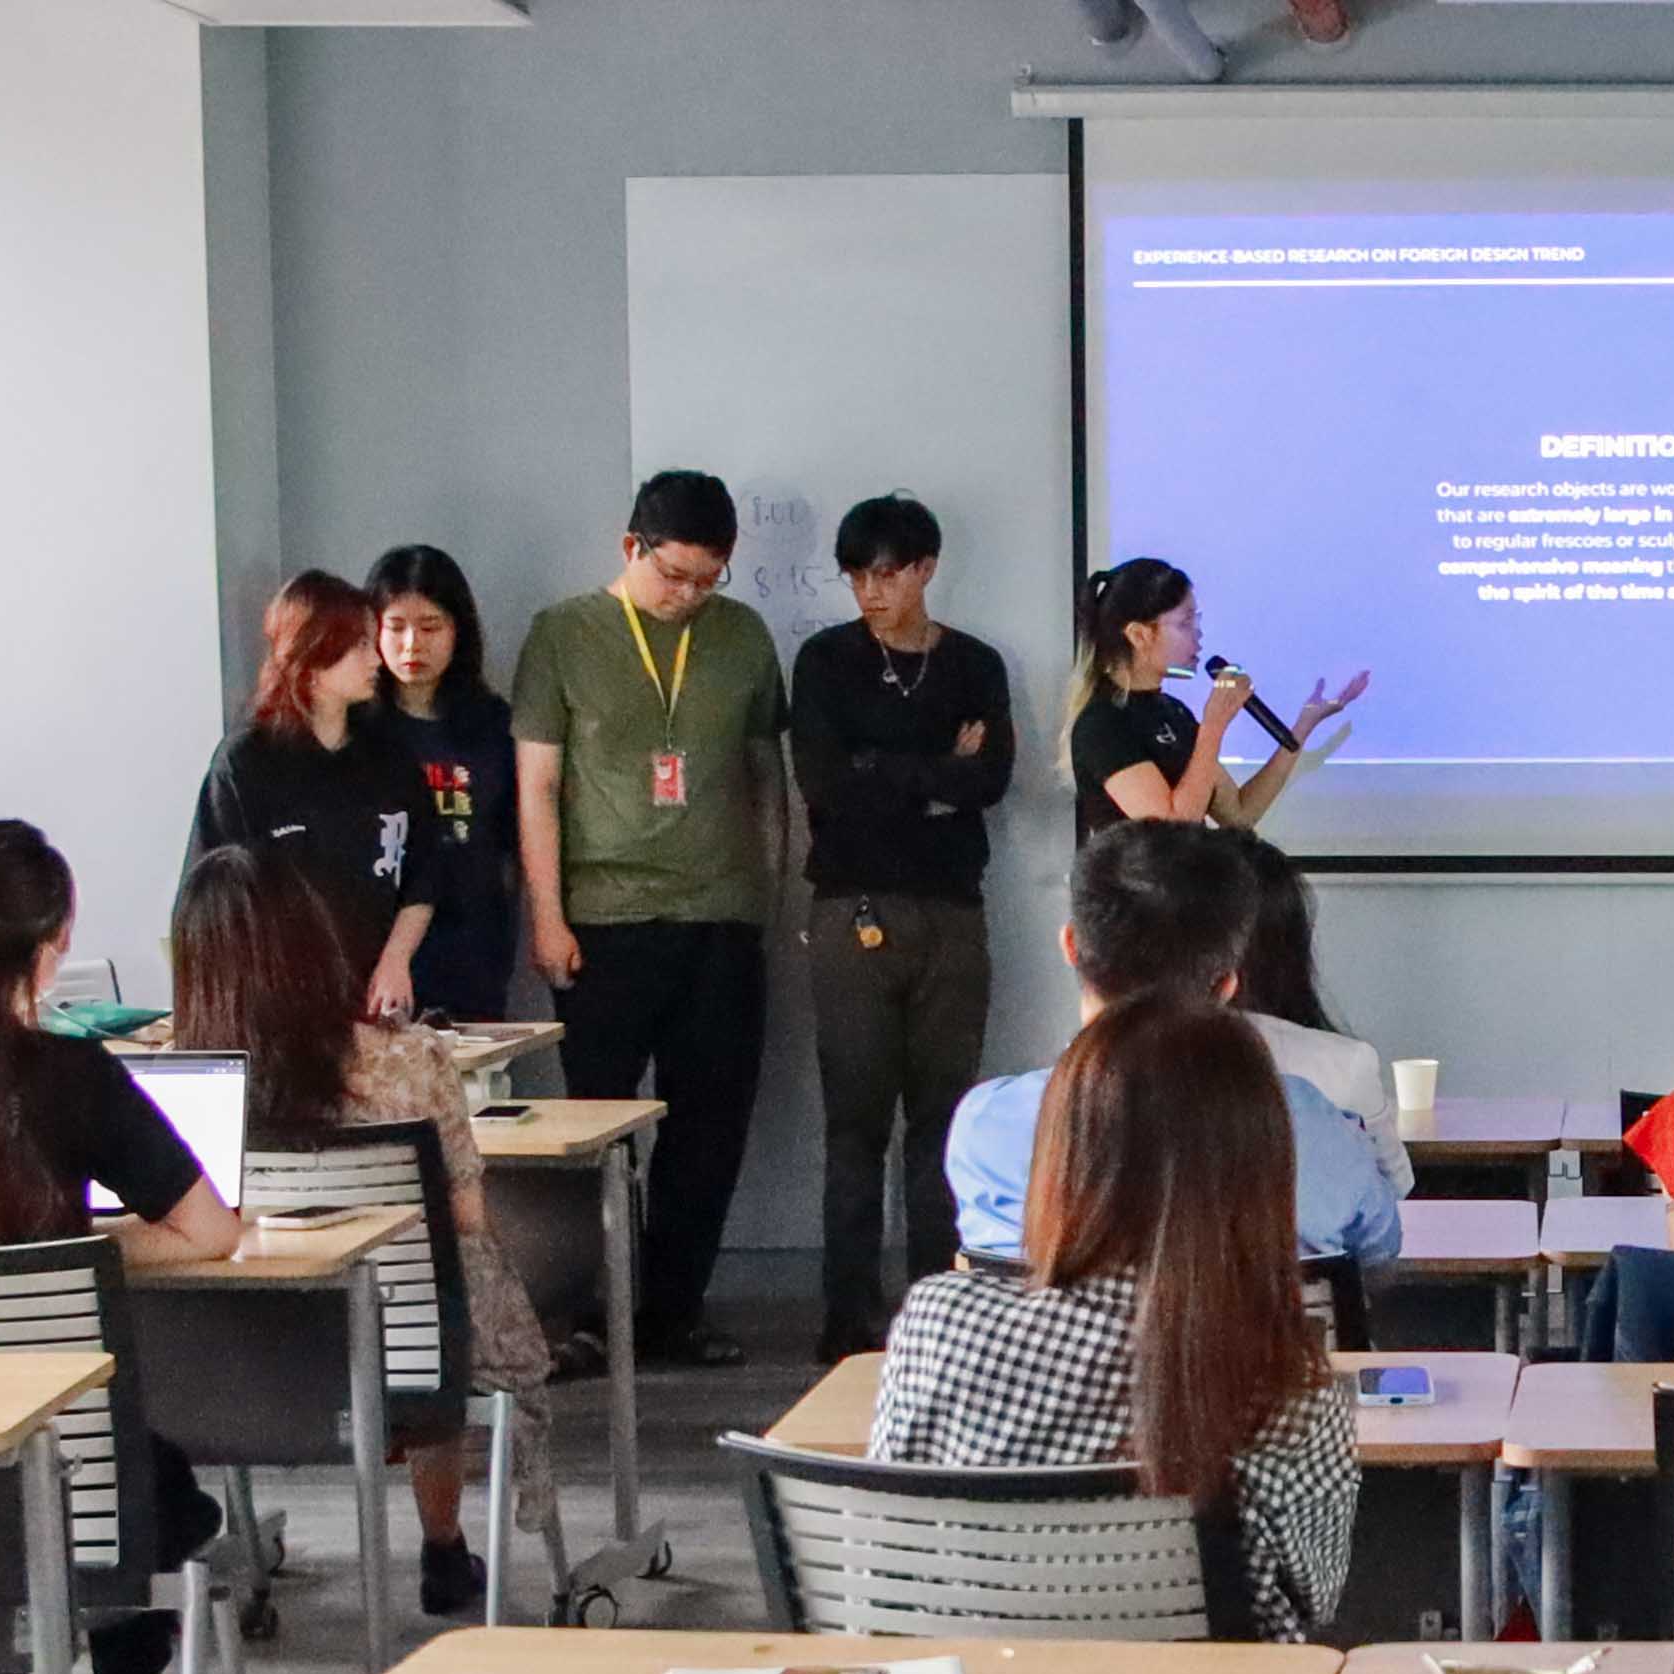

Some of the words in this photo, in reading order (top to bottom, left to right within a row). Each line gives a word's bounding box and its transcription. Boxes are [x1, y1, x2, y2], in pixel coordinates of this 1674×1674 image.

[1133, 249, 1285, 265] EXPERIENCE-BASED
[1288, 249, 1369, 263] RESEARCH
[1372, 248, 1397, 263] ON
[1399, 247, 1468, 263] FOREIGN
[1470, 247, 1530, 262] DESIGN
[1532, 247, 1586, 262] TREND
[1436, 482, 1470, 498] Our
[1474, 481, 1549, 498] research
[1552, 480, 1616, 500] objects
[1619, 484, 1648, 497] are
[1436, 508, 1473, 523] that
[1477, 510, 1505, 522] are
[1507, 506, 1601, 525] extremely
[1603, 506, 1651, 525] large
[1654, 506, 1673, 521] in
[1452, 534, 1472, 549] to
[1475, 533, 1538, 551] regular
[1541, 533, 1614, 549] frescoes
[1616, 536, 1635, 549] or
[1438, 557, 1580, 577] comprehensive
[1582, 556, 1664, 577] meaning
[1477, 585, 1511, 600] the
[1513, 583, 1562, 603] spirit
[1564, 583, 1584, 600] of
[1586, 583, 1619, 600] the
[1621, 583, 1665, 600] time
